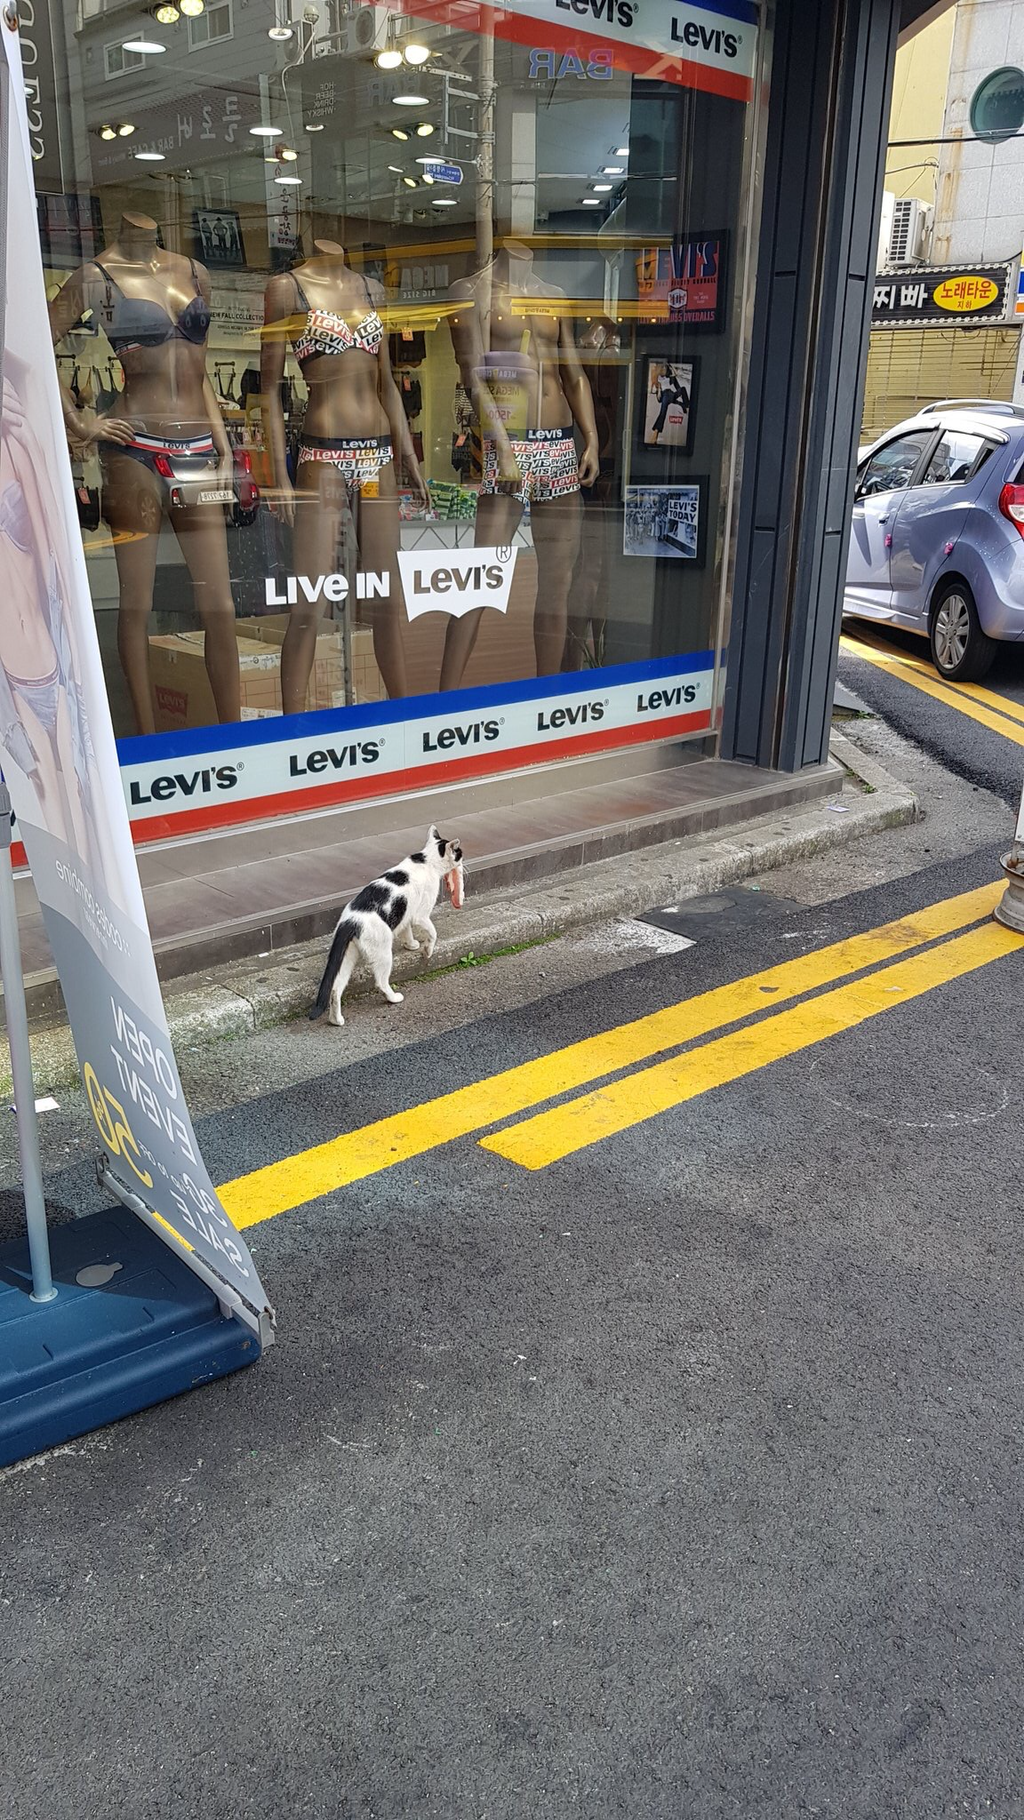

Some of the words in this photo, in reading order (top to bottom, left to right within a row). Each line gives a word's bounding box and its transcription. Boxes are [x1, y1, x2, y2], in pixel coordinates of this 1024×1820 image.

[940, 280, 993, 300] 노래타운
[956, 301, 973, 310] 지하
[669, 501, 697, 513] LEVI'S
[669, 509, 696, 523] TODAY
[356, 571, 390, 599] IN
